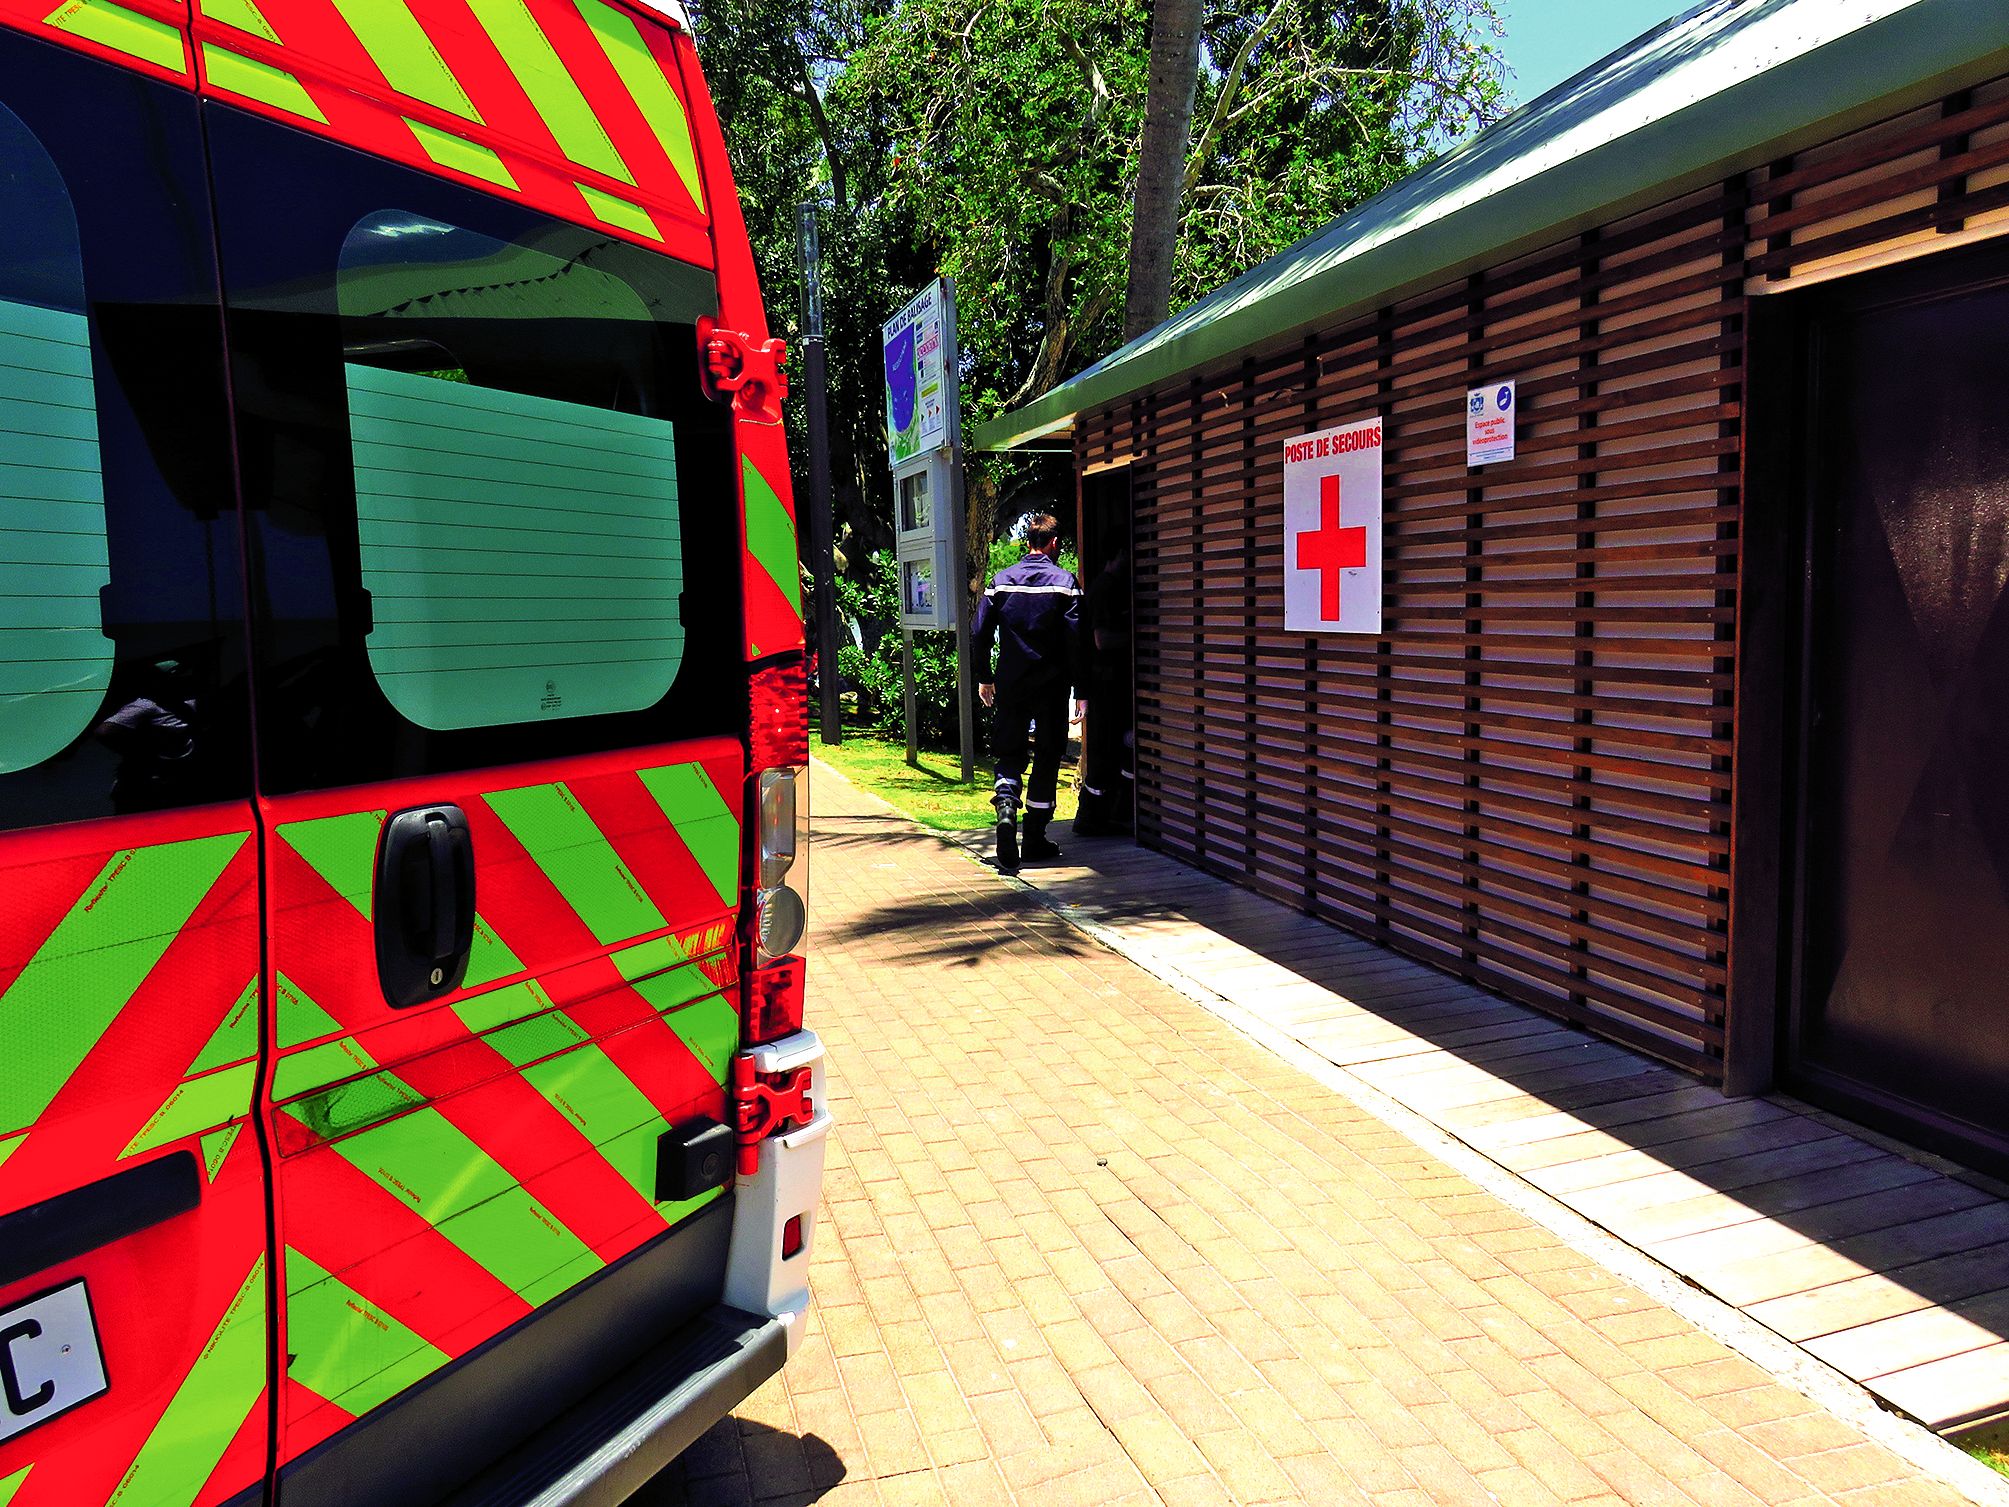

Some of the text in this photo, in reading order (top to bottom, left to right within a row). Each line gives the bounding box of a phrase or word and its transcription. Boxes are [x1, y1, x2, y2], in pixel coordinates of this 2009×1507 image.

[900, 312, 907, 329] DE
[1474, 417, 1505, 429] Espace public
[1284, 425, 1381, 465] POSTE DE SECOURS
[0, 1317, 56, 1416] C
